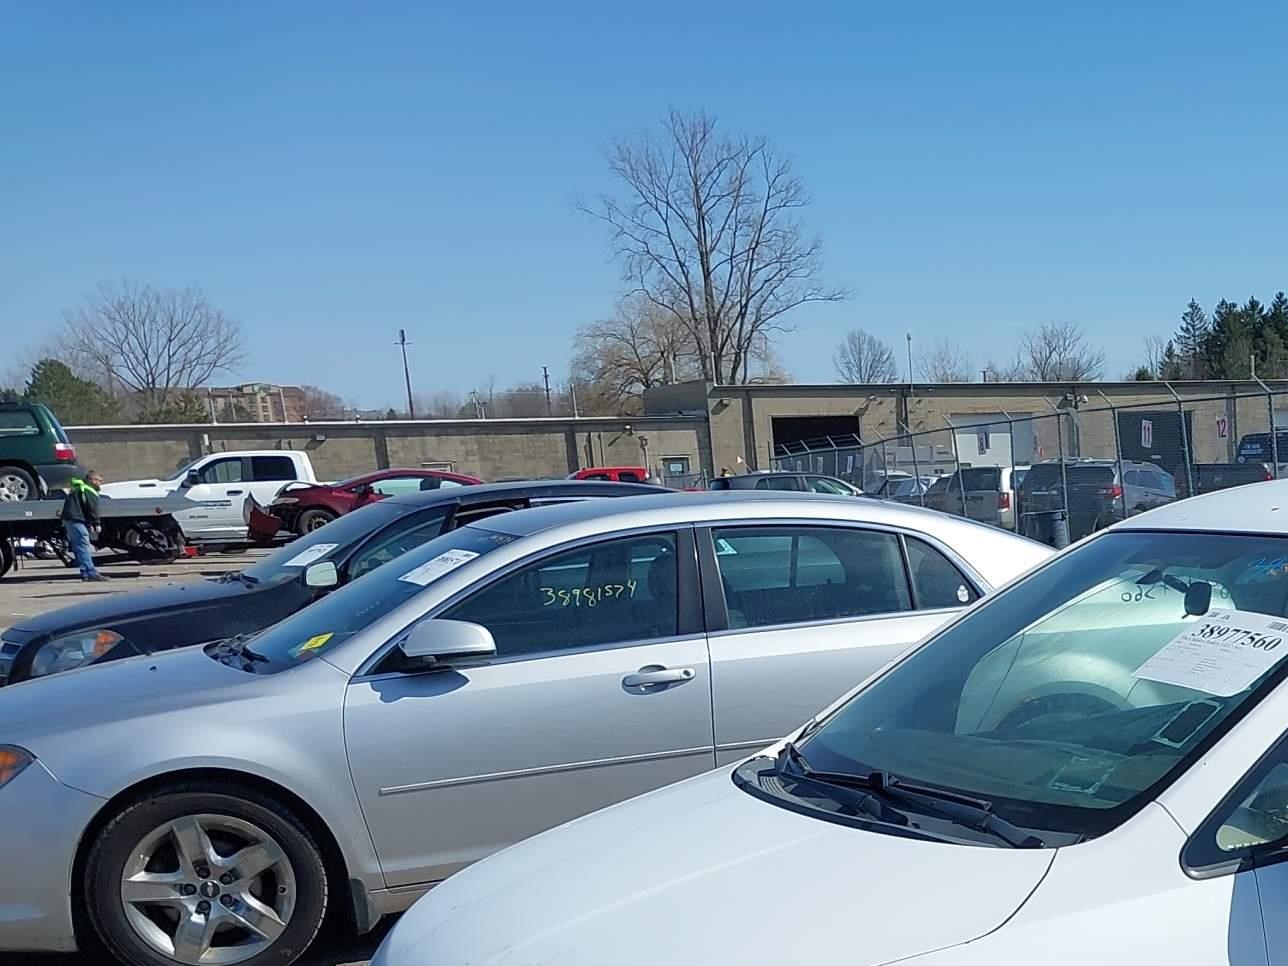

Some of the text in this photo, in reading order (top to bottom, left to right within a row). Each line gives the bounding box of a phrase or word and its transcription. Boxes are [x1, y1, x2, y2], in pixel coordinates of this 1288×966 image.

[1142, 420, 1152, 445] 11
[1216, 419, 1228, 438] 12
[540, 579, 637, 606] 38981574
[1191, 623, 1282, 651] 38977560
